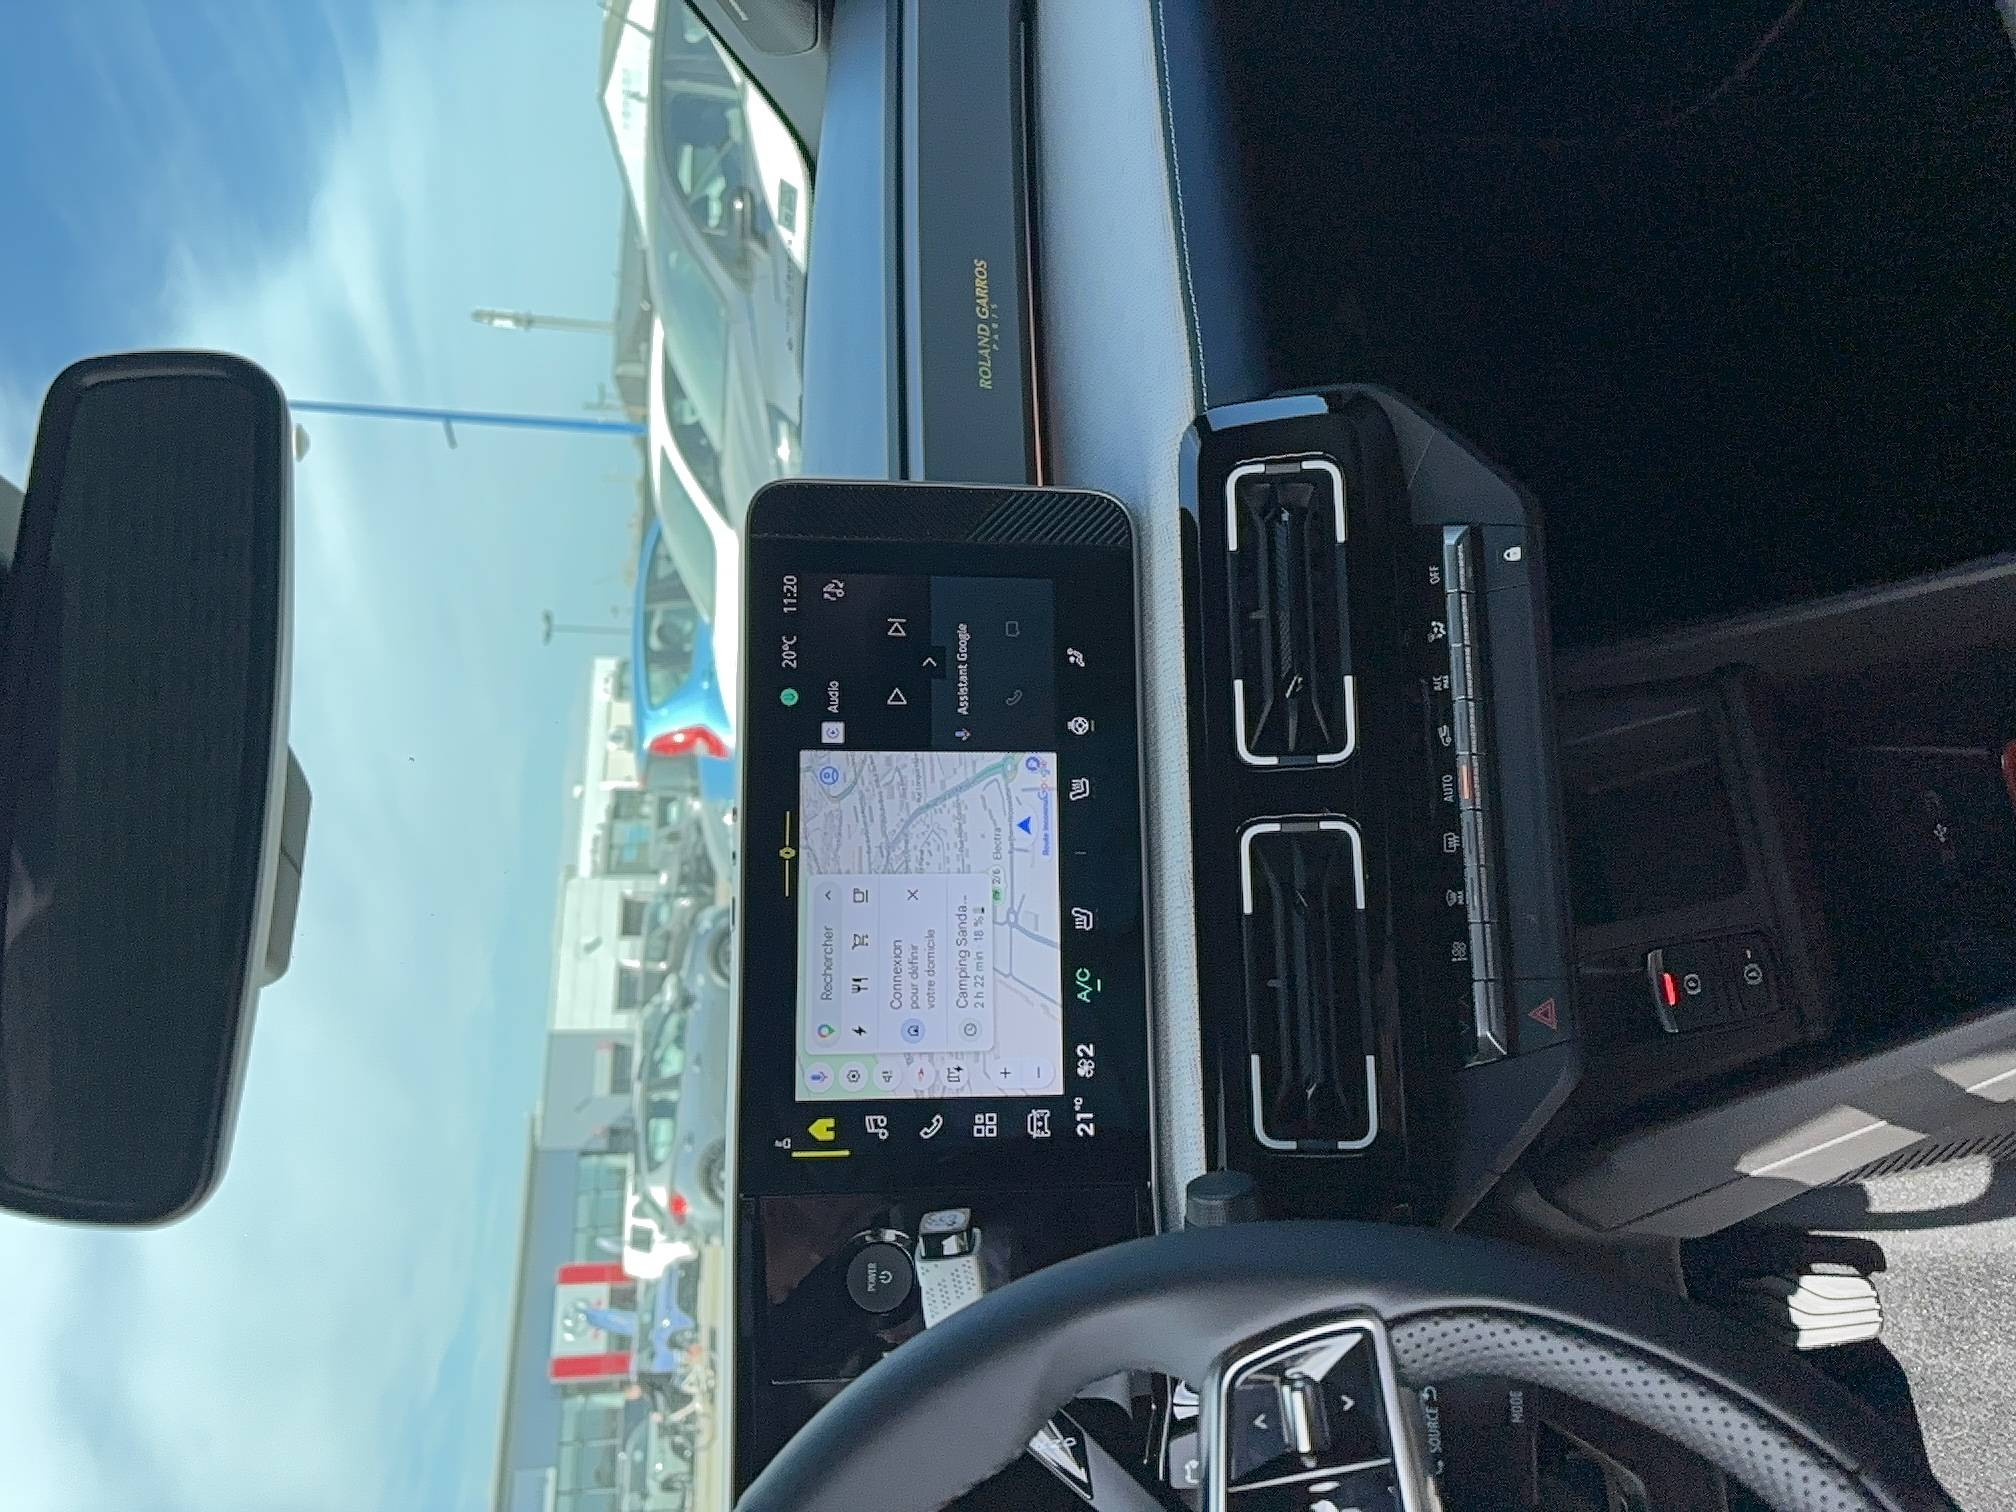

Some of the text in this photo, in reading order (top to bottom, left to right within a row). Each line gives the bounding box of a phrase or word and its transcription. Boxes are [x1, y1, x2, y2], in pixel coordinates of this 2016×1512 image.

[973, 259, 993, 389] ROLAND GARROS
[990, 304, 999, 351] PARIS
[1428, 564, 1441, 584] OFF
[782, 575, 797, 613] 11:20
[780, 635, 797, 669] 20°C
[956, 623, 971, 715] Assistant Google
[826, 680, 840, 713] Audio
[1441, 774, 1454, 802] AUTO
[992, 827, 1002, 861] Electra
[973, 930, 985, 941] 18
[820, 925, 834, 1001] Rechercher
[889, 939, 903, 1010] Connexion
[907, 943, 920, 1010] pour définir
[923, 928, 936, 1009] votre domicile
[973, 951, 984, 972] min
[956, 949, 971, 1009] Camping
[973, 975, 985, 988] 22
[973, 991, 985, 999] h
[1075, 967, 1093, 1003] A/C
[973, 1001, 985, 1009] 2
[1075, 1043, 1095, 1058] 2
[867, 1263, 877, 1292] POWER
[1425, 1407, 1442, 1454] SOURCE
